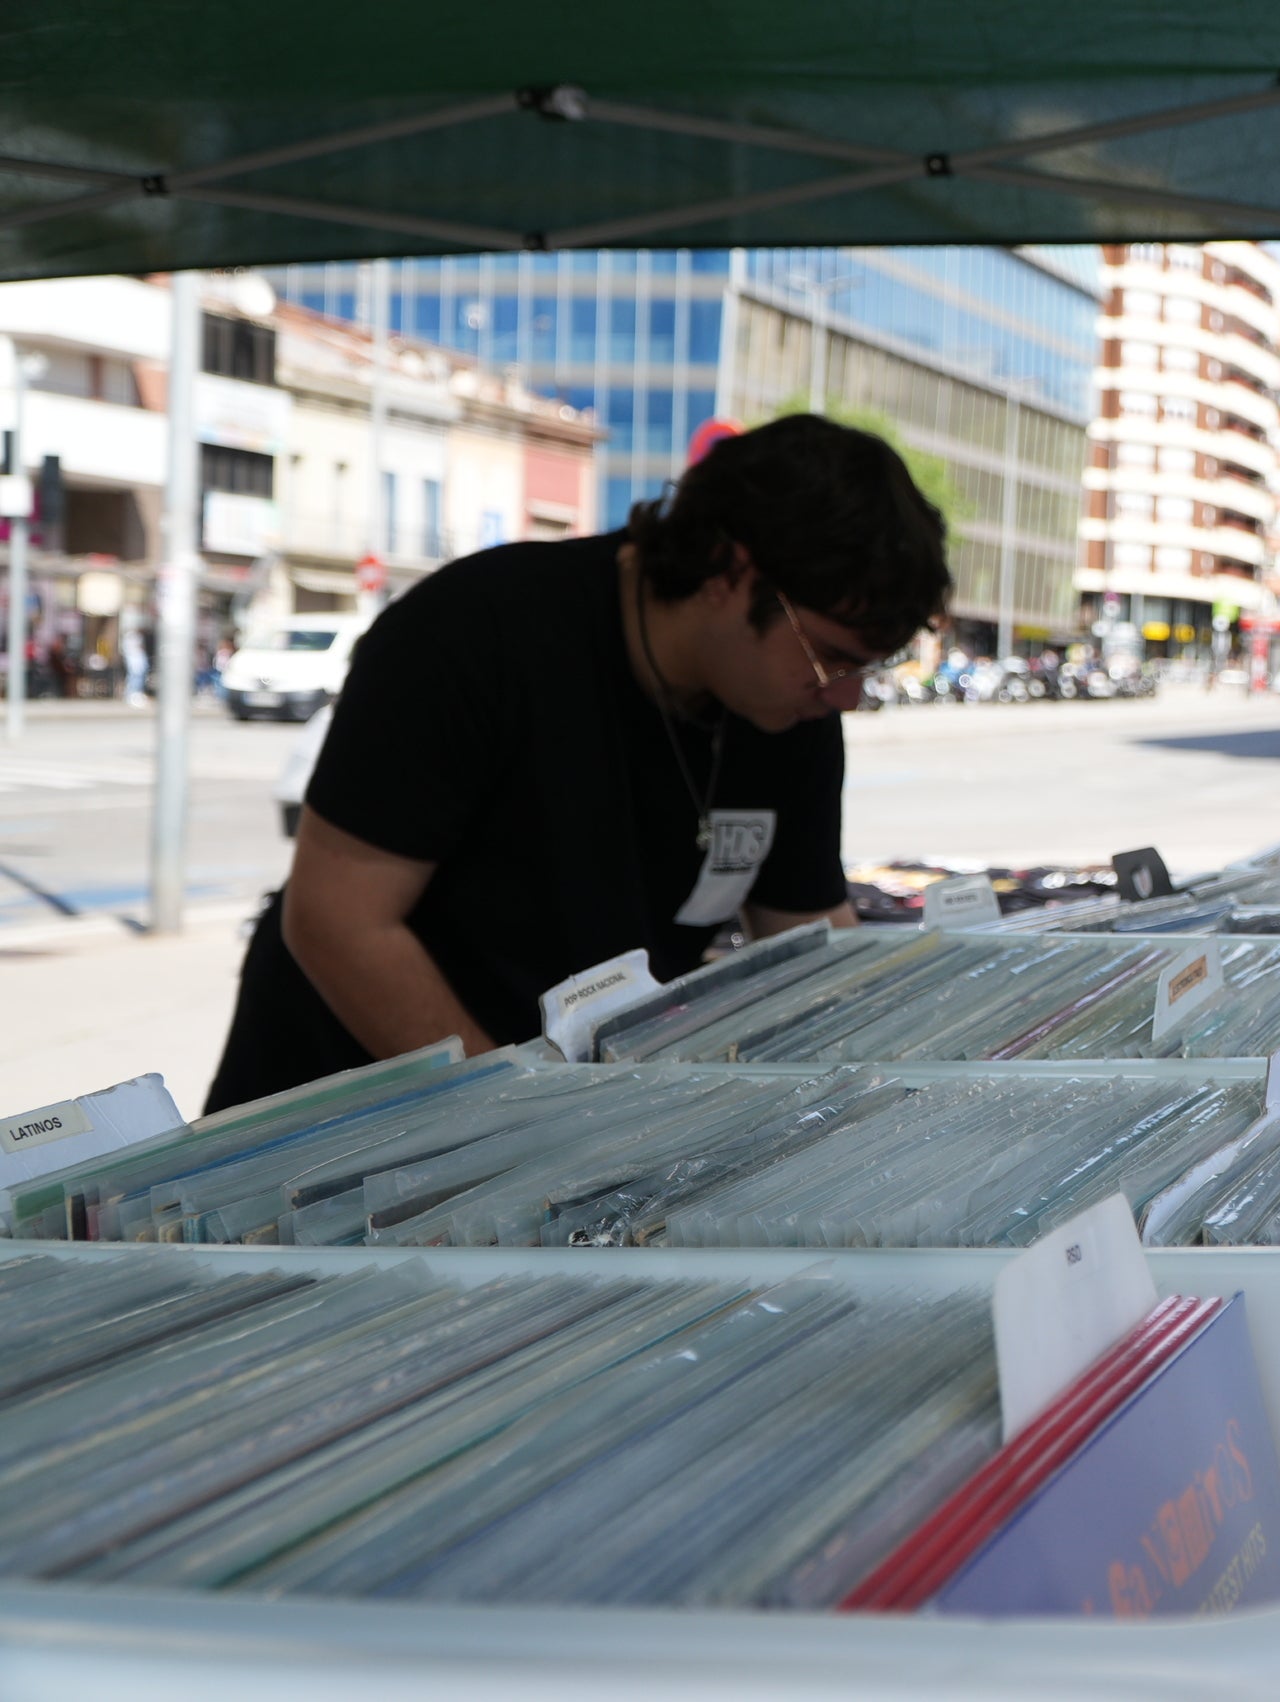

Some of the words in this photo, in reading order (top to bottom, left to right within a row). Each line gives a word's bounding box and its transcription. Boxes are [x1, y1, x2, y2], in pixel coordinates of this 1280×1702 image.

[578, 985, 597, 1000] ROCK
[9, 1117, 63, 1142] LATINOS
[1237, 1521, 1267, 1584] HITS
